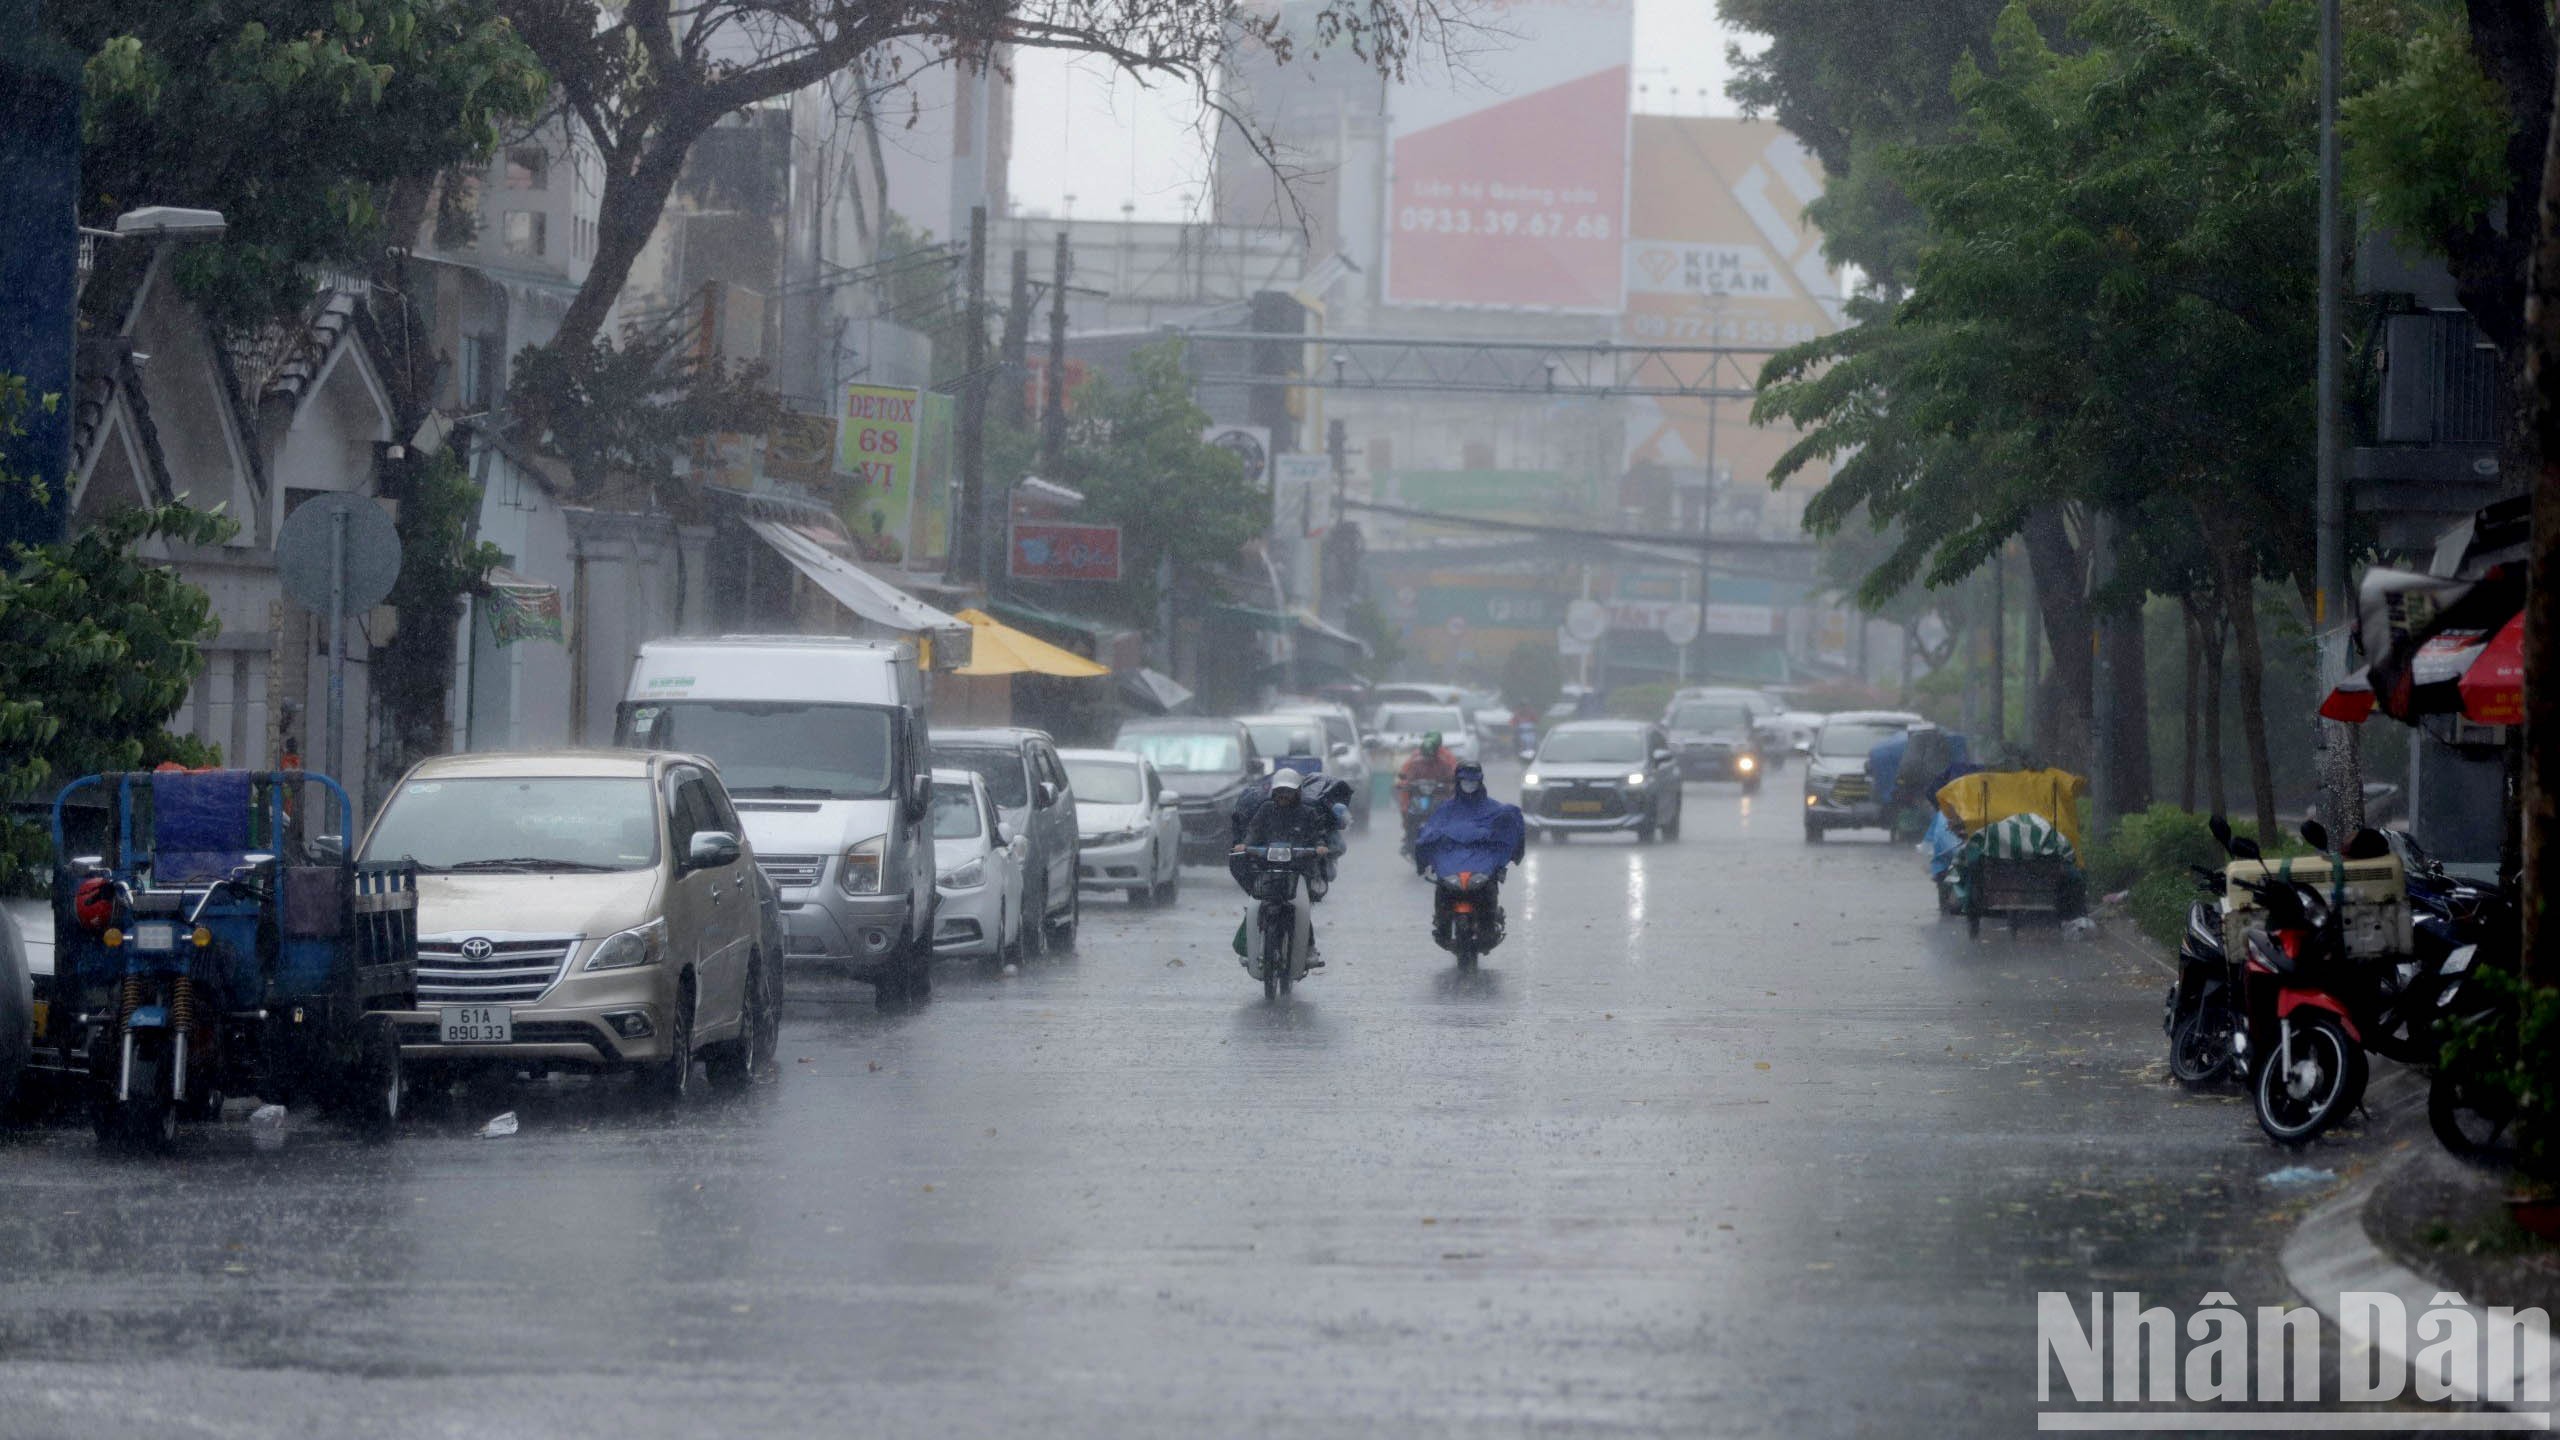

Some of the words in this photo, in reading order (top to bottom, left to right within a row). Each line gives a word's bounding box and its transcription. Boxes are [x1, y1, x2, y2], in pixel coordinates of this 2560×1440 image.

[1400, 206, 1610, 240] 0933.39.67.68
[1684, 251, 1739, 271] KIM
[847, 394, 916, 423] DETOX
[859, 428, 898, 455] 68
[461, 1009, 491, 1024] 61A
[449, 1025, 504, 1040] 890.33
